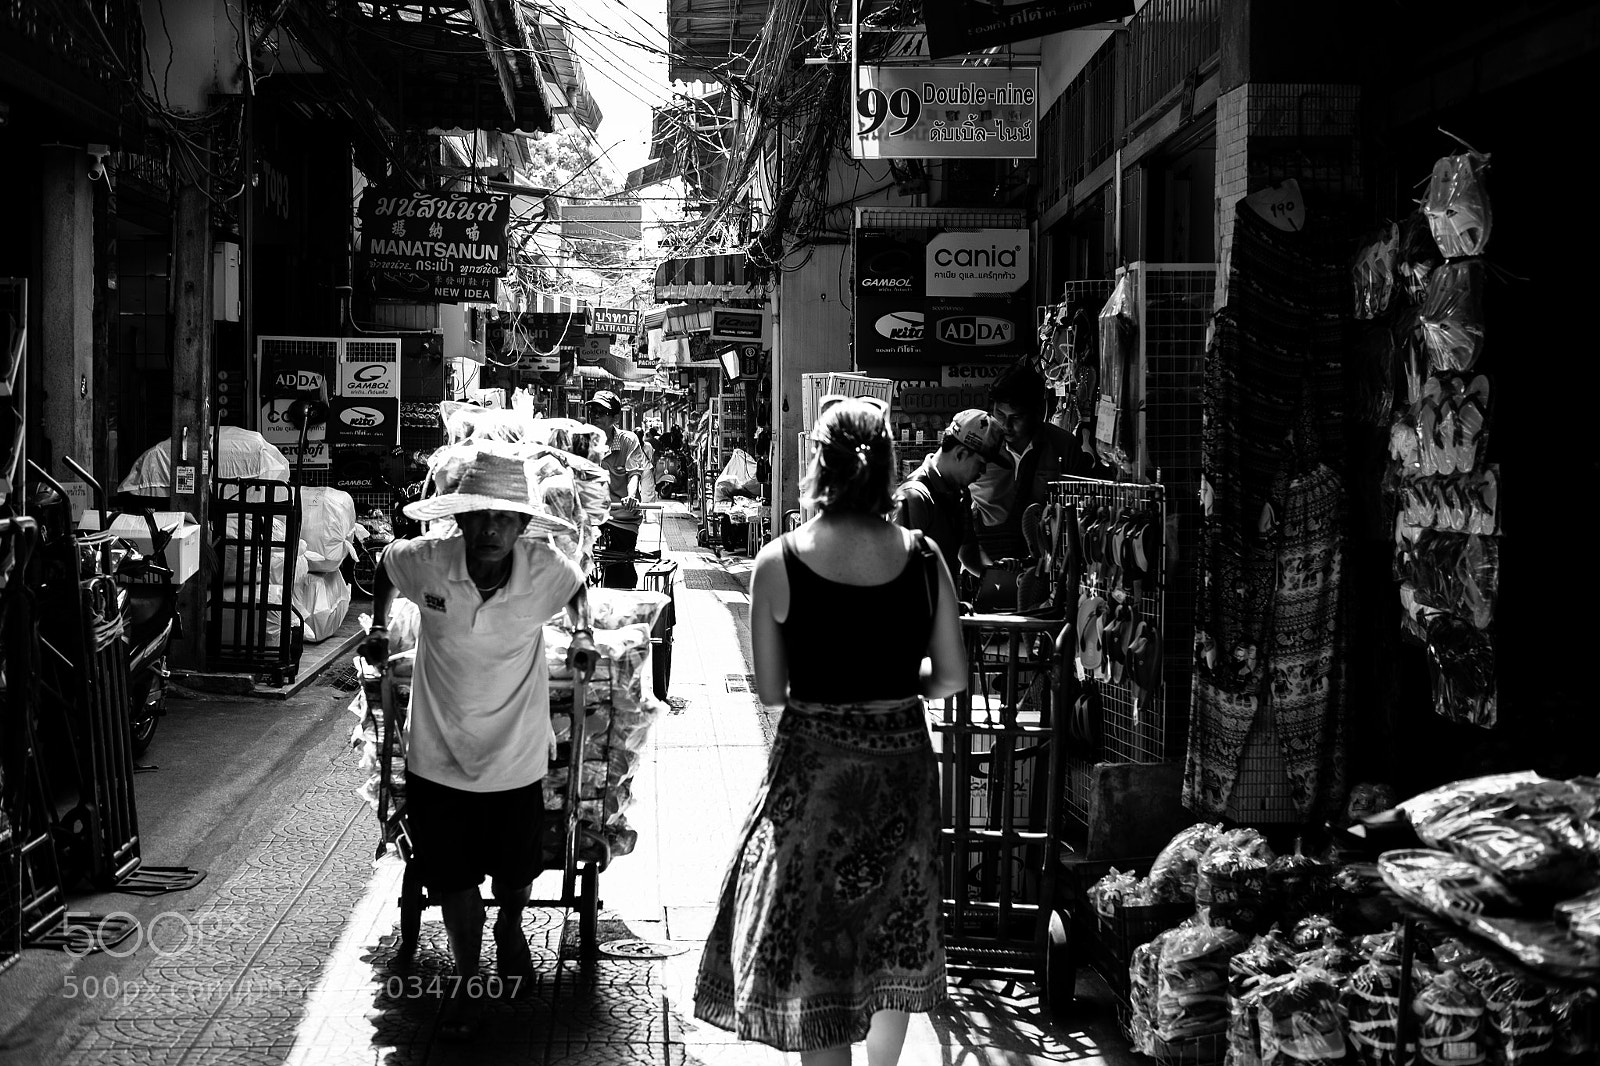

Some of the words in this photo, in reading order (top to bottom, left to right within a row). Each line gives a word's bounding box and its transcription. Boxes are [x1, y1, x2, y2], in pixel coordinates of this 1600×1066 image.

[922, 82, 1034, 106] Double-nine
[857, 89, 921, 137] 99
[375, 191, 503, 222] มนัสนันท์
[370, 238, 499, 261] MANATSANUN
[934, 244, 1015, 267] cania
[861, 278, 912, 287] GAMBOL
[434, 287, 460, 298] NEW
[464, 289, 491, 299] IDEA
[595, 324, 637, 335] BATHADEE
[944, 322, 1005, 340] ADDA
[275, 373, 319, 388] ADDA
[346, 381, 390, 389] GAMBOL
[337, 479, 372, 487] GAMBOL
